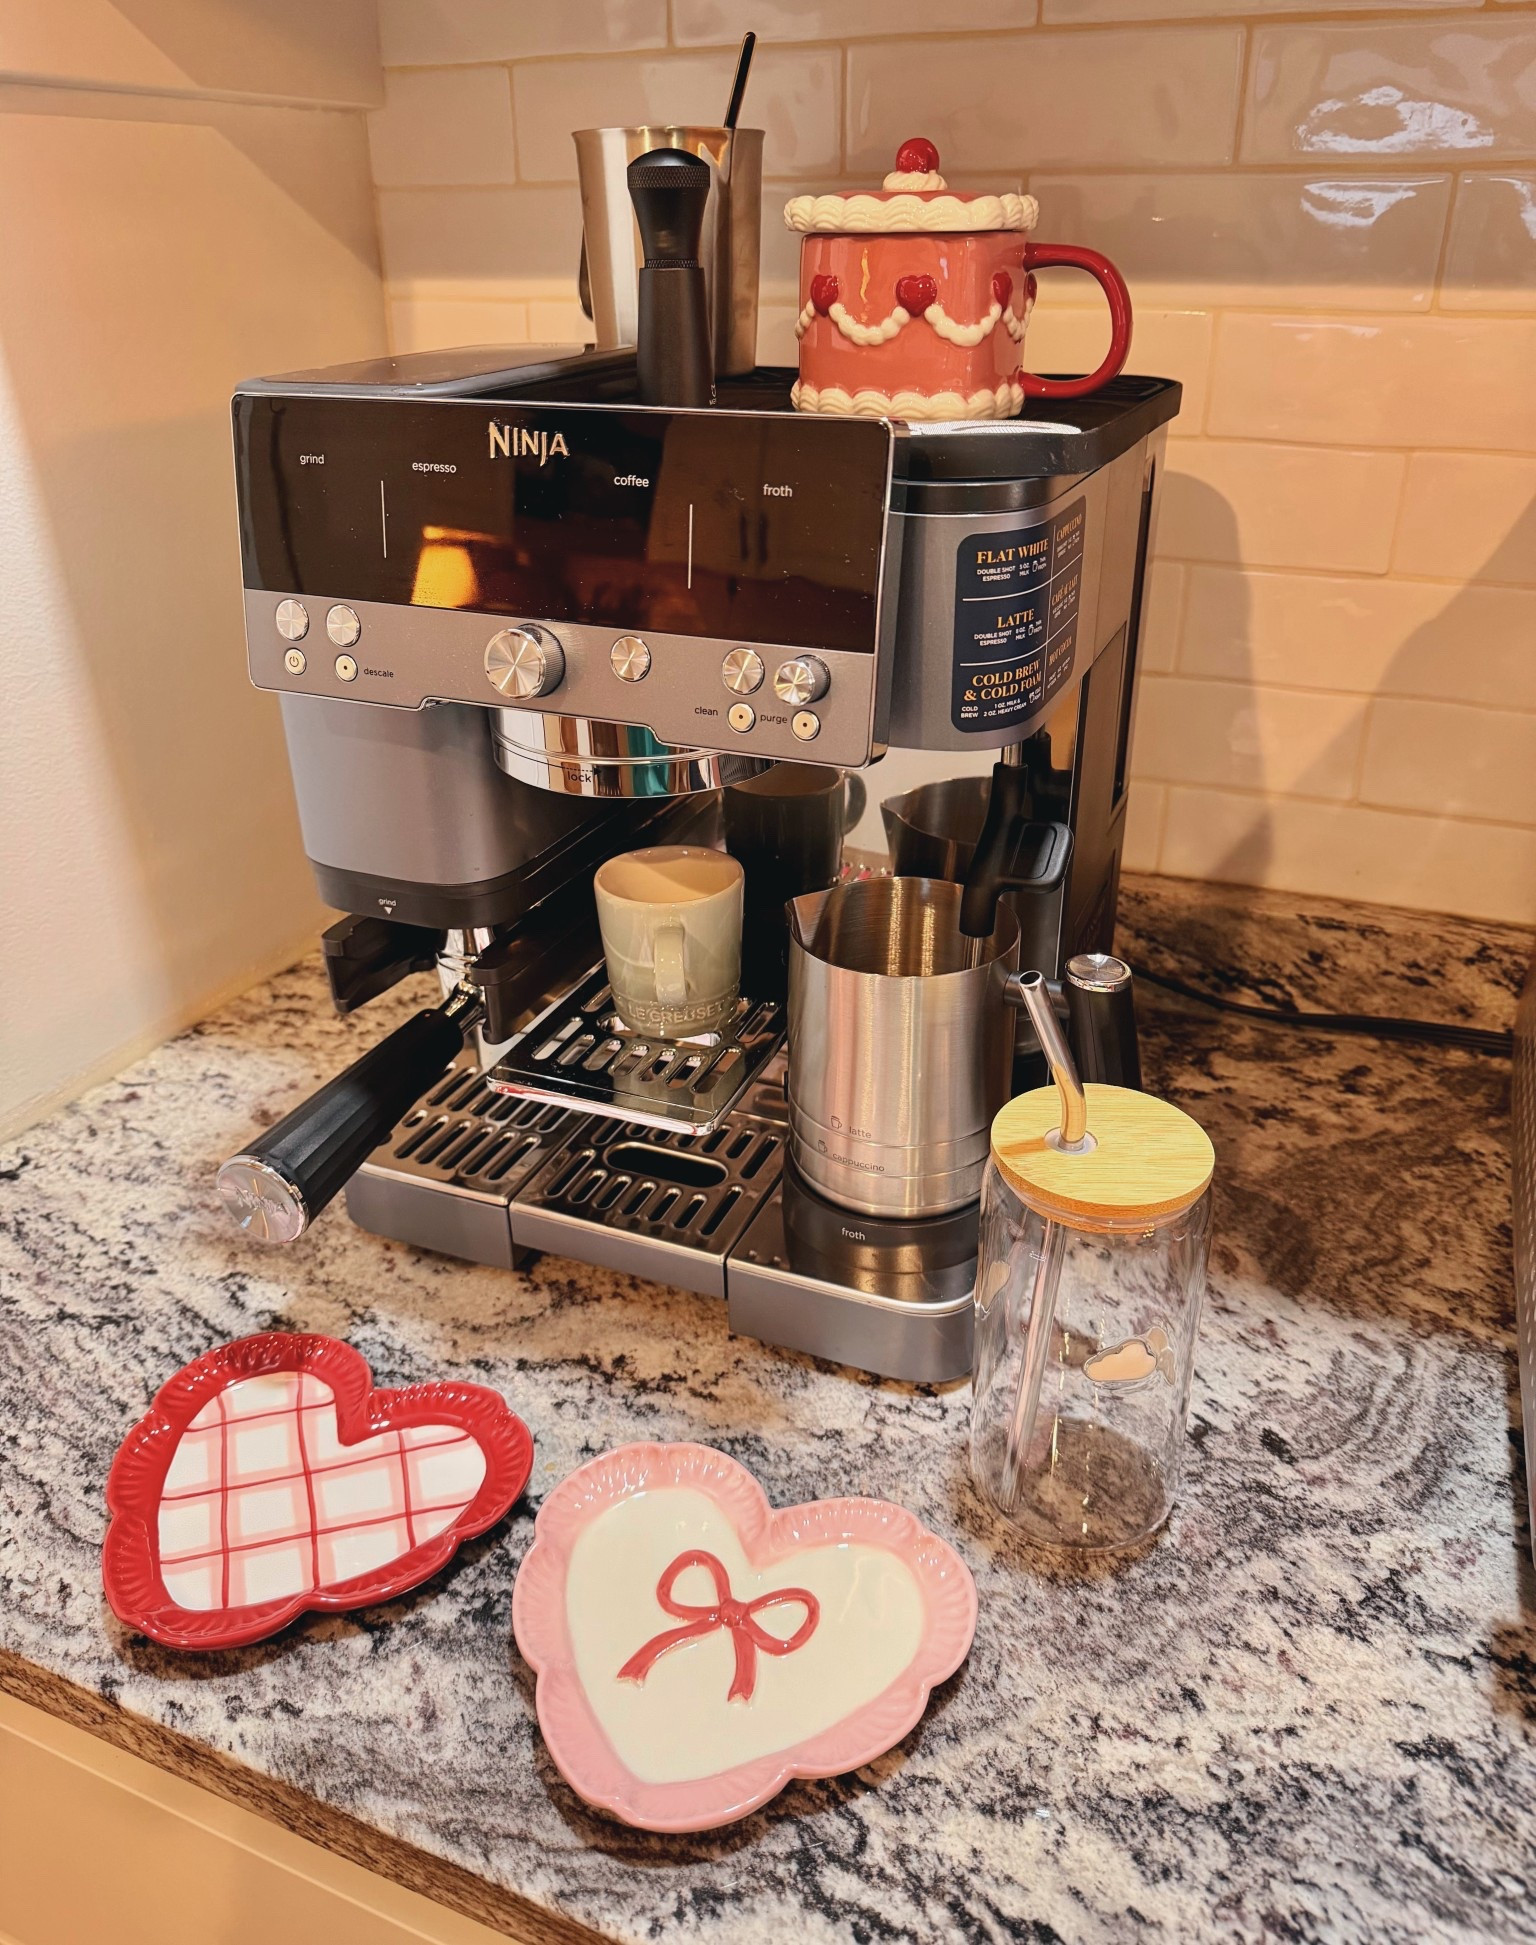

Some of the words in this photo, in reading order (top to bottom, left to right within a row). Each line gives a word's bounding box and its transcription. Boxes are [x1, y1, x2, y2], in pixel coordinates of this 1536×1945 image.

[488, 421, 569, 466] NINJA
[299, 454, 325, 465] grind
[412, 462, 457, 473] espresso
[613, 475, 650, 488] coffee
[762, 483, 793, 497] froth
[976, 548, 1016, 564] FLAT
[1018, 538, 1049, 559] WHITE
[976, 567, 1001, 575] DOUBLE
[1001, 565, 1016, 573] SHOT
[982, 573, 1011, 582] ESPRESSO
[997, 608, 1035, 629] LATTE
[973, 632, 998, 640] DOUBLE
[998, 630, 1012, 638] SHOT
[979, 638, 1008, 646] ESPRESSO
[363, 667, 394, 678] descale
[972, 671, 1014, 687] COLD
[1015, 658, 1041, 681] BREW
[963, 689, 977, 701] &
[980, 683, 1019, 700] COLD
[1020, 671, 1042, 692] FOAM
[694, 706, 719, 716] clean
[760, 714, 788, 724] purge
[567, 770, 592, 783] lock
[378, 898, 397, 906] grind
[628, 1005, 646, 1020] LE
[849, 1126, 872, 1139] latte
[832, 1152, 885, 1172] cappuccino
[841, 1227, 867, 1241] froth
